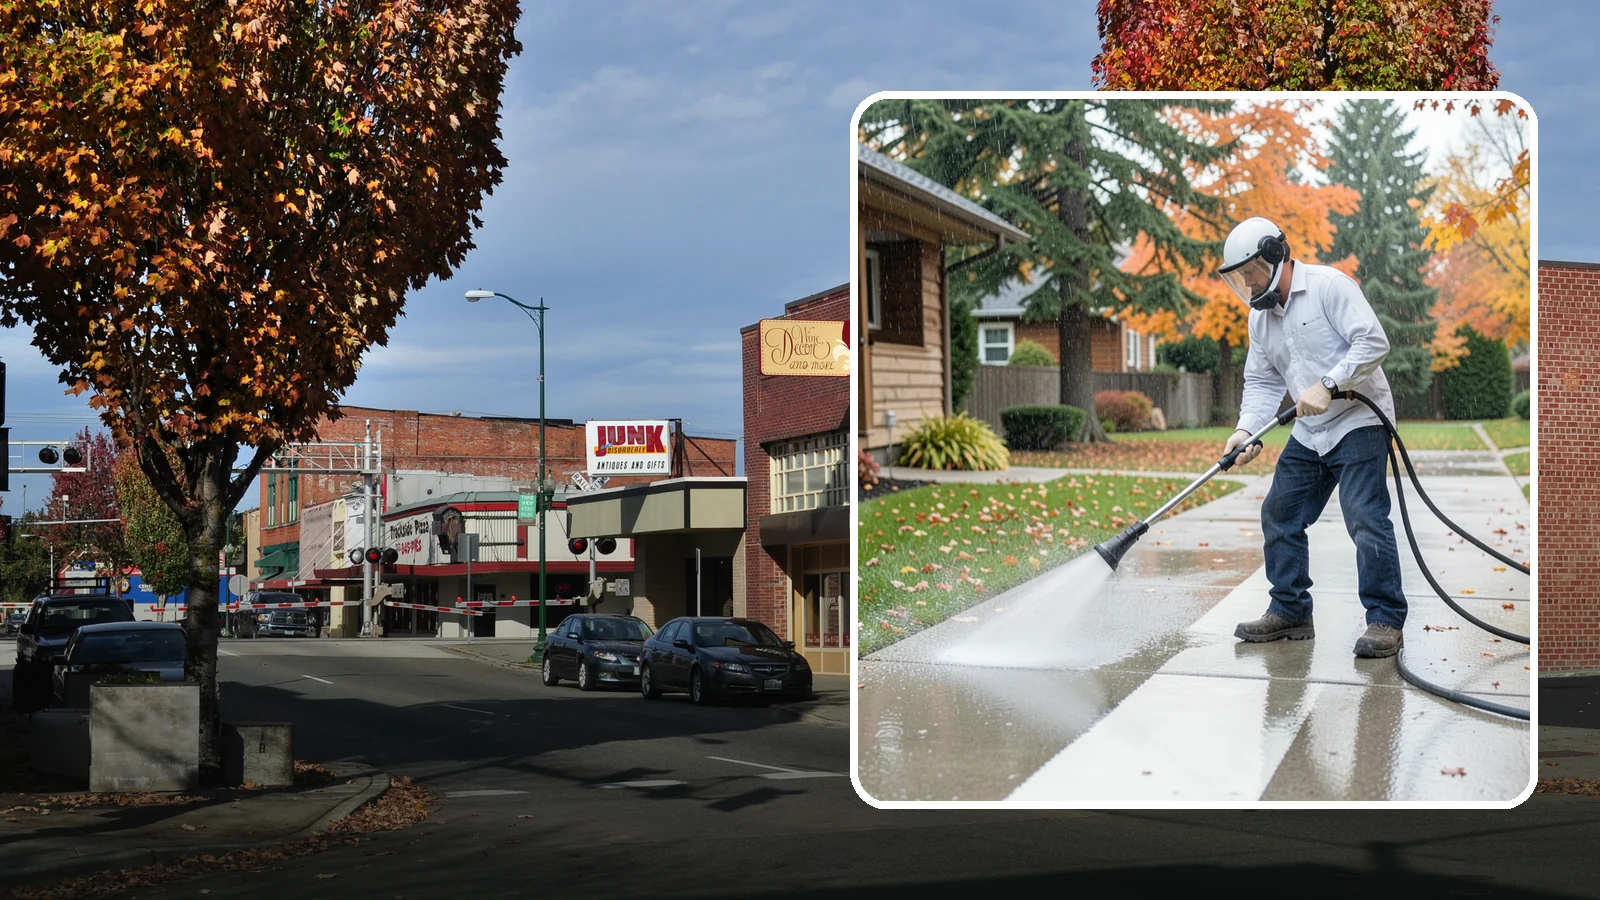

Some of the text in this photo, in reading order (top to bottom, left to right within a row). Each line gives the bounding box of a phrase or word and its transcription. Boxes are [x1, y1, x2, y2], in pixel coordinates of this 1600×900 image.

[791, 325, 823, 345] Wine
[765, 327, 831, 366] Decor
[596, 425, 665, 457] JUNK
[607, 446, 646, 454] DISORDERLY
[596, 460, 665, 470] ANTIQUES AND GIFTS
[414, 519, 429, 535] Pizza
